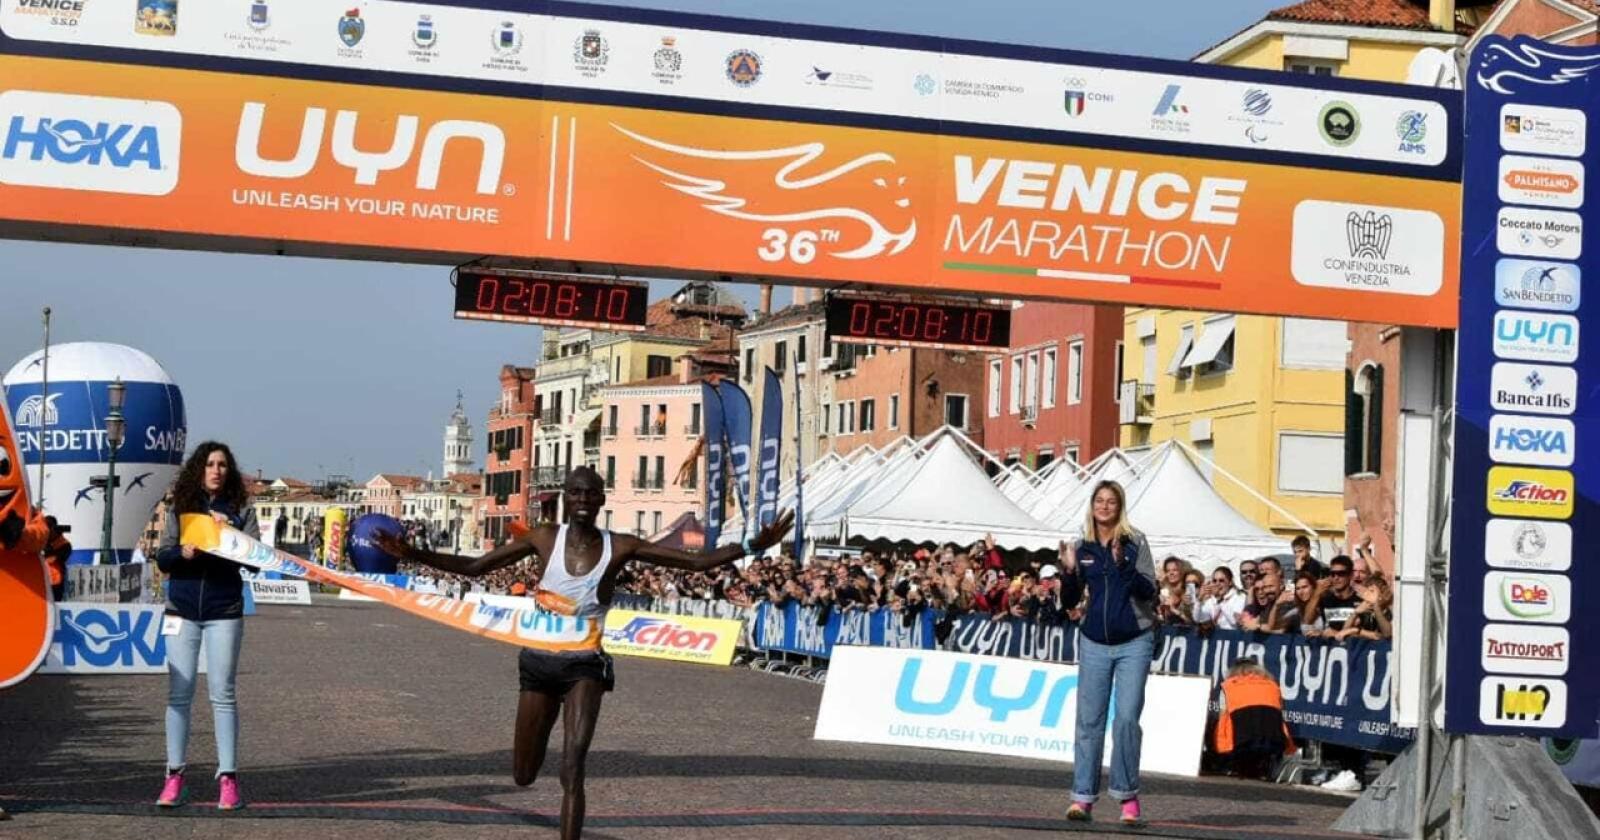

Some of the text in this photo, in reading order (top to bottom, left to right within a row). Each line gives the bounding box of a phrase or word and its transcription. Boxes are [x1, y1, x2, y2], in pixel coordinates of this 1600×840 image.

[1087, 91, 1114, 102] CONI
[3, 115, 162, 170] HOKA
[1397, 142, 1426, 155] AIMS
[954, 155, 1248, 226] VENICE
[1514, 174, 1570, 189] PALMISANO
[232, 189, 499, 224] UNLEASH YOUR NATURE
[1499, 217, 1581, 234] Ceccato Motors
[943, 214, 1232, 273] MARATHON
[1323, 257, 1411, 276] CONFINDUSTRIA
[1344, 272, 1390, 287] VENEZIA
[476, 278, 628, 321] 02:08:10
[849, 303, 993, 343] 02:08:10
[1496, 389, 1543, 407] Banca
[1494, 426, 1567, 454] HOKA
[1501, 480, 1567, 502] Action
[253, 581, 298, 594] Bavaria
[1511, 584, 1548, 601] Dole
[46, 608, 167, 667] HOK
[620, 616, 718, 650] Action
[1487, 638, 1565, 658] TUTTOSPORT
[888, 724, 975, 743] UNLEASH
[978, 731, 1029, 748] YOUR
